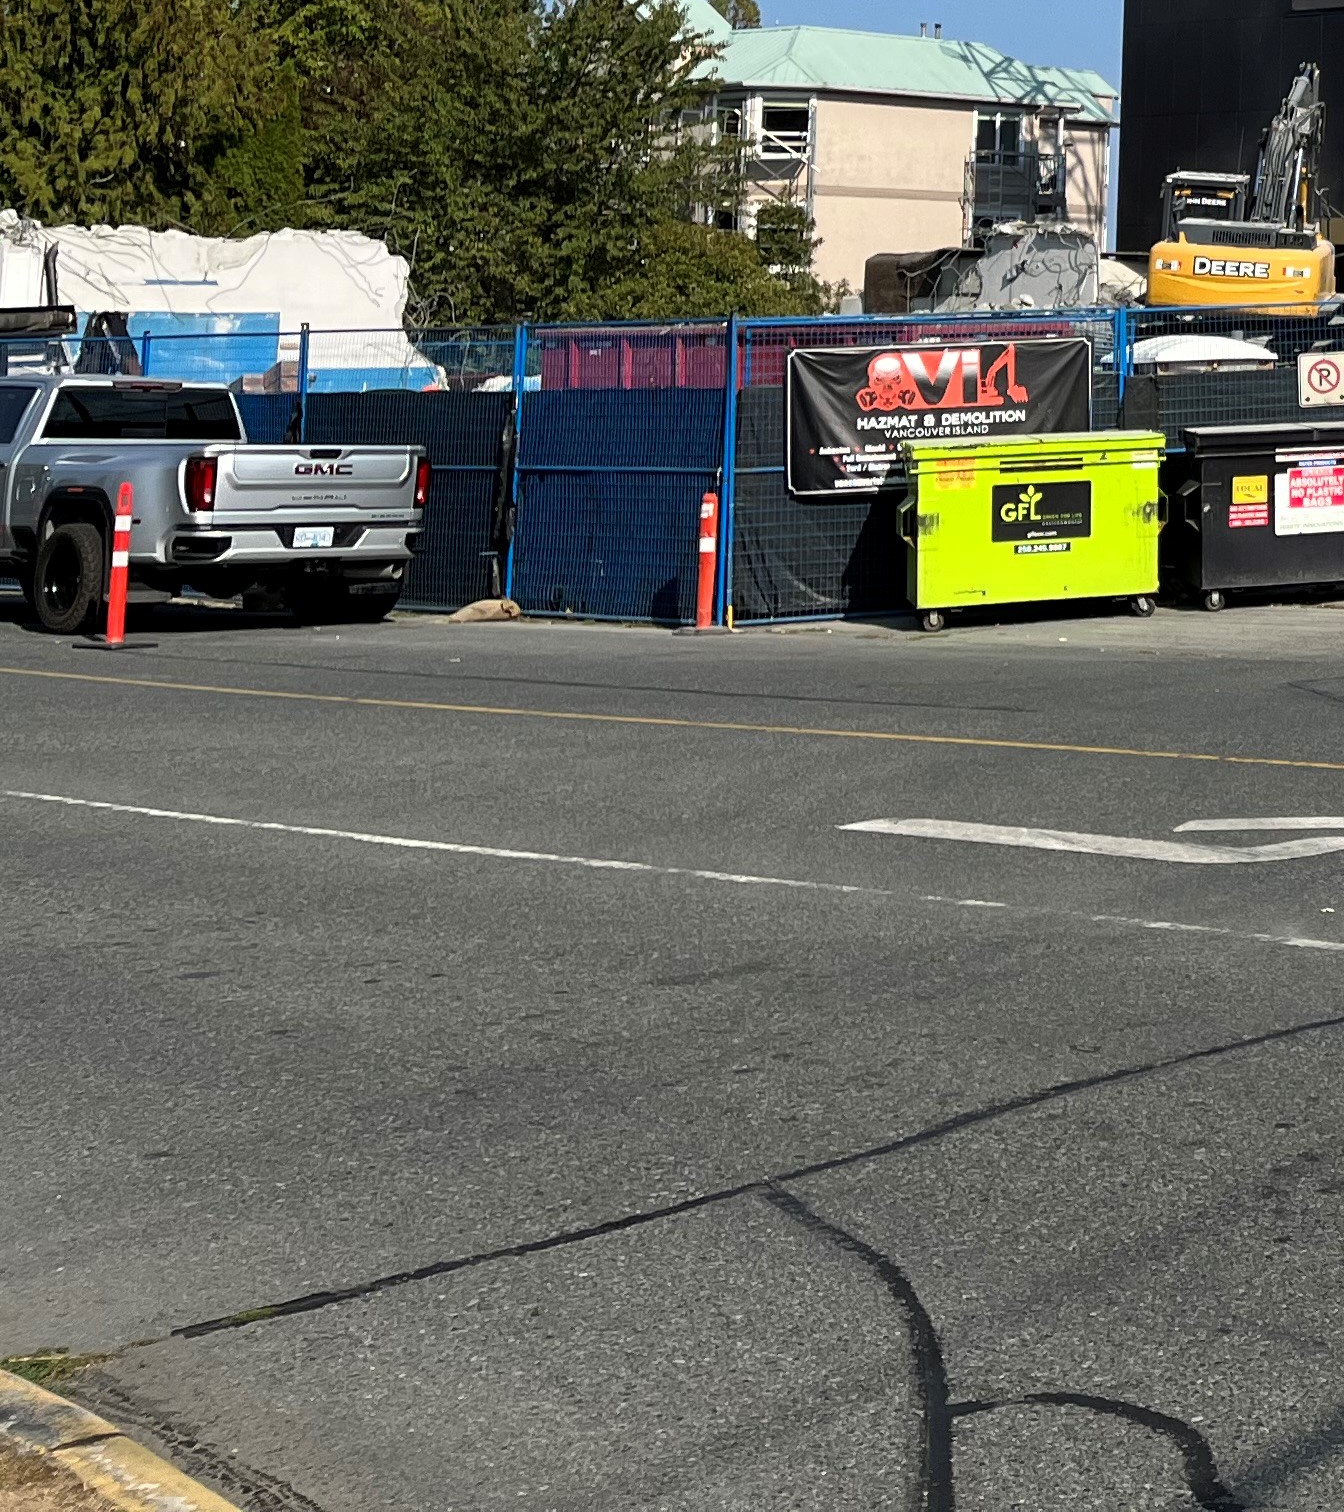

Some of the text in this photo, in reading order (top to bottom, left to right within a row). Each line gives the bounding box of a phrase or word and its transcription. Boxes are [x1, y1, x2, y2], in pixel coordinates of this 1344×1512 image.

[1202, 197, 1227, 206] DEERE
[1194, 256, 1270, 278] DEERE
[856, 409, 1026, 431] HAZMAT & DEMOLITION
[884, 424, 989, 439] VANCOUVER ISLAND
[293, 463, 353, 476] GMC
[1290, 475, 1344, 487] ABSOLUTELY
[1291, 486, 1344, 498] NO PLASTIC
[1000, 492, 1043, 522] GFL
[1303, 496, 1332, 507] BAGS
